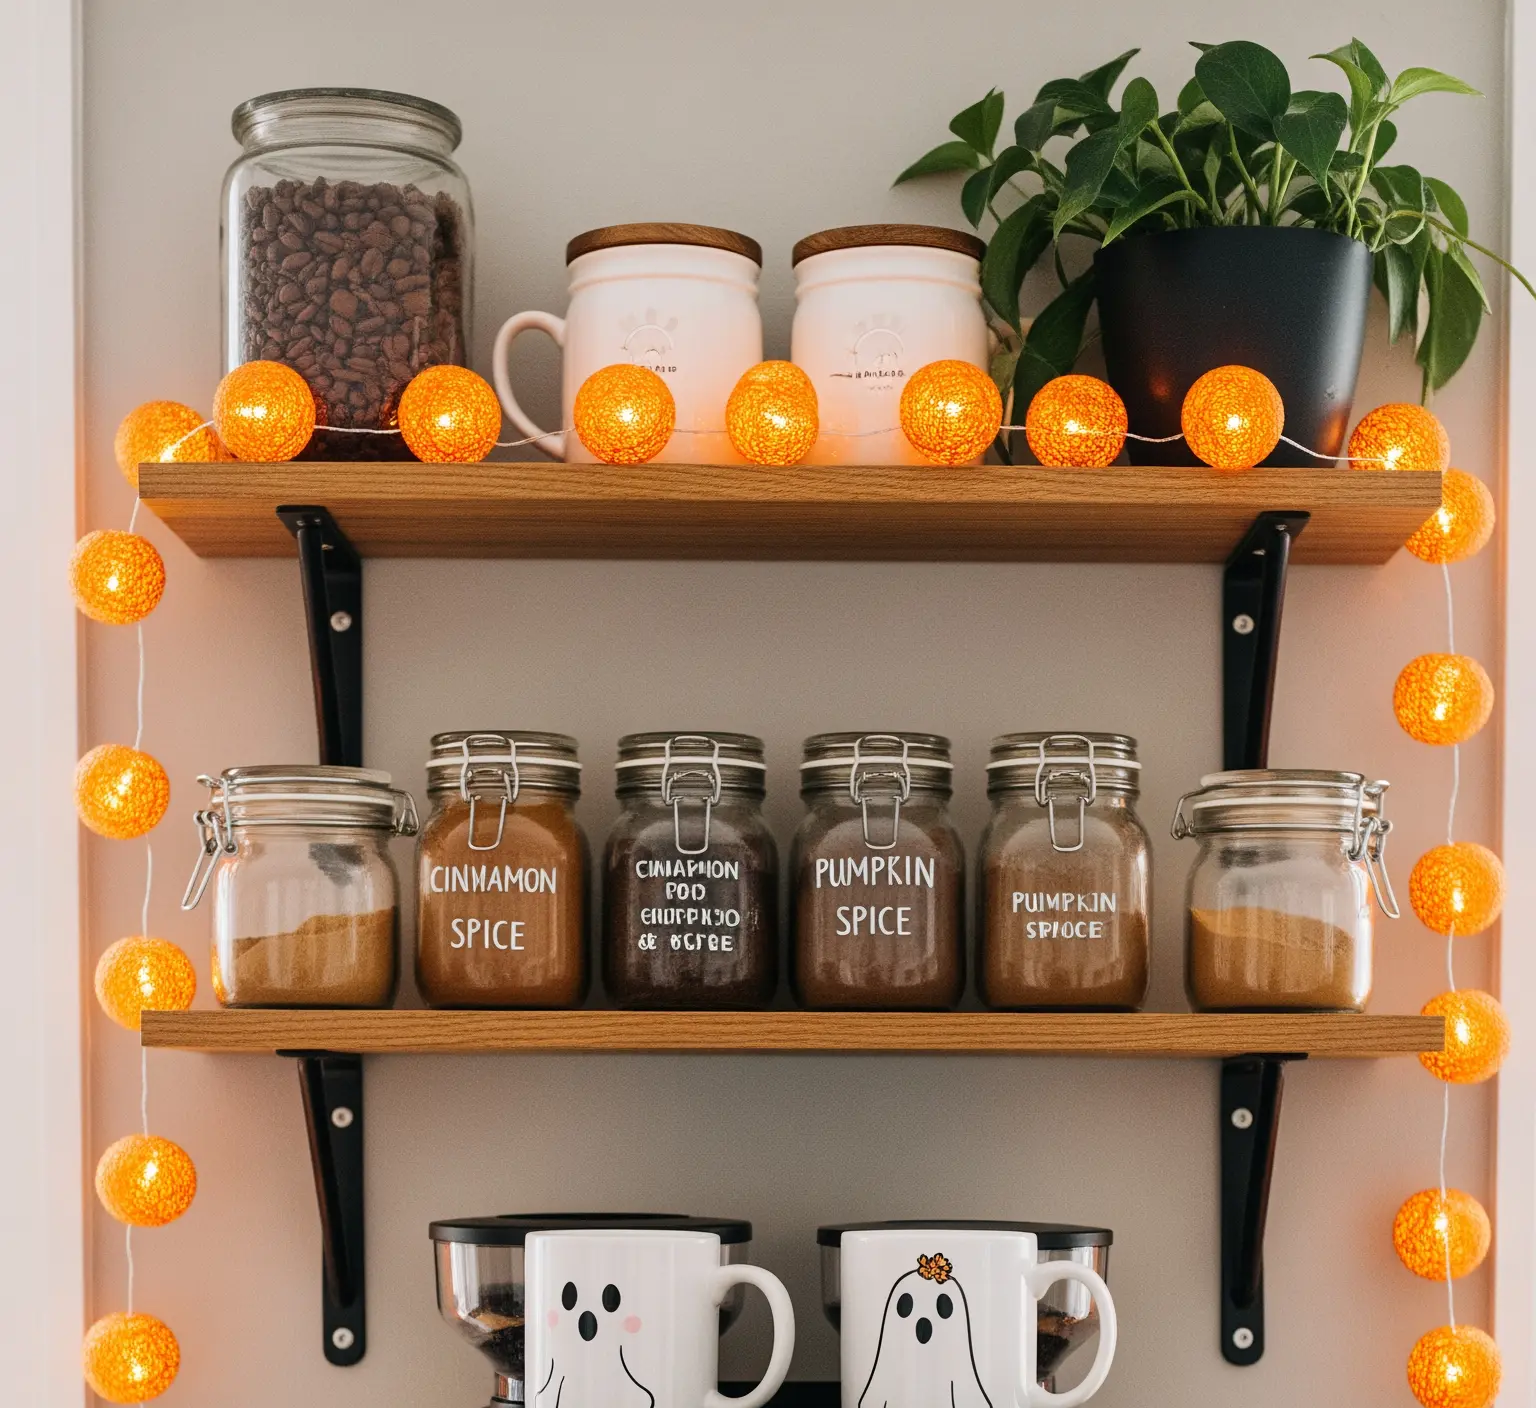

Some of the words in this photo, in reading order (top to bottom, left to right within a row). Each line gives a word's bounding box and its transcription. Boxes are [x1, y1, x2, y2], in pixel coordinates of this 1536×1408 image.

[430, 864, 557, 895] CINNAMON
[815, 855, 935, 888] PUMPKIN
[450, 918, 526, 950] SPICE
[836, 905, 912, 936] SPICE
